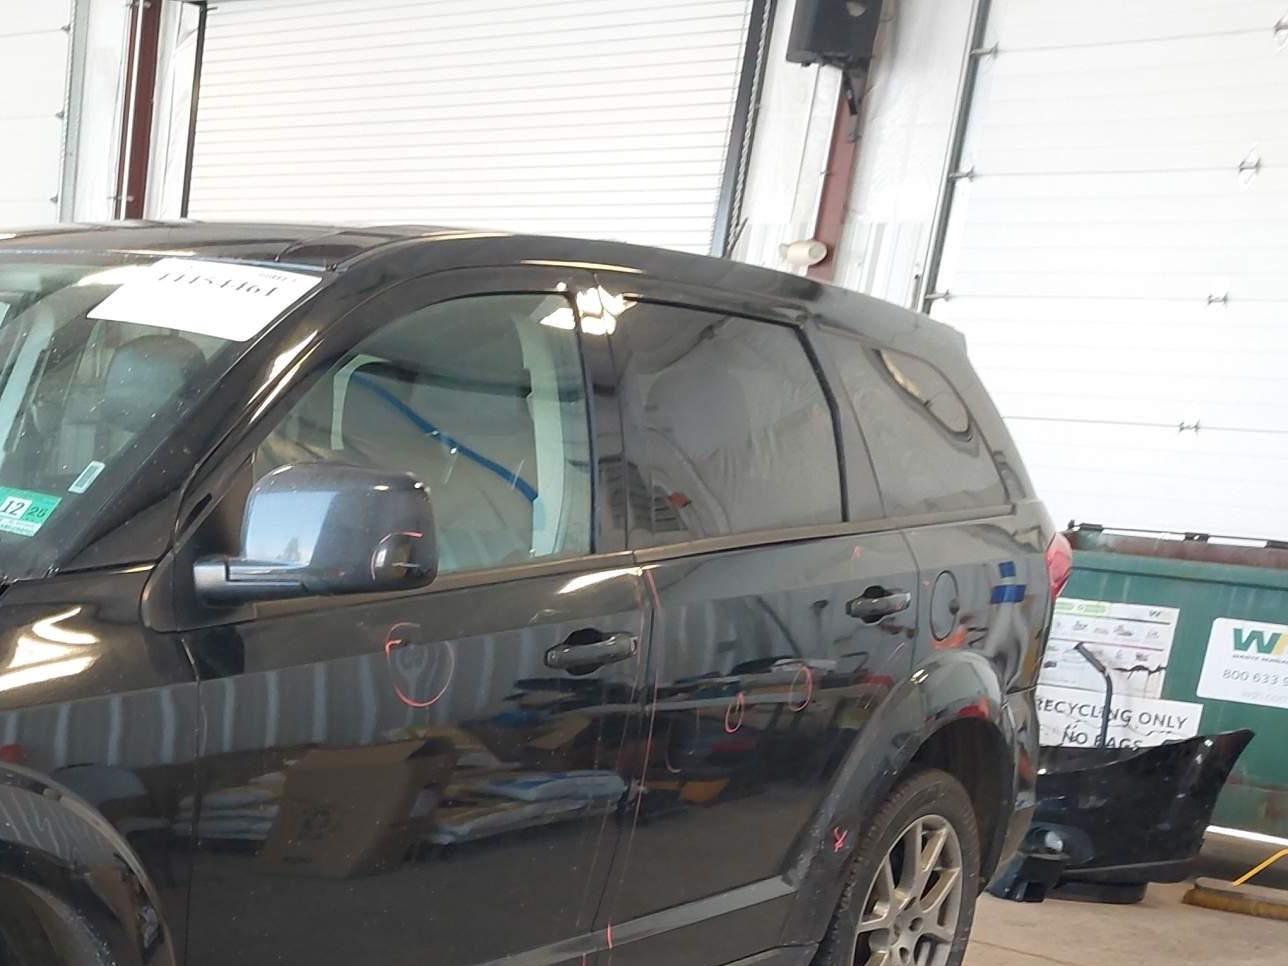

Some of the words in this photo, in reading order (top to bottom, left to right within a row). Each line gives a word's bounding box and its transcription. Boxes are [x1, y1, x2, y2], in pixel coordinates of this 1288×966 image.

[0, 500, 25, 516] 12
[1223, 669, 1249, 681] 800
[1037, 697, 1132, 724] RECYCLNG
[1139, 711, 1188, 730] ONLY
[1062, 729, 1088, 745] NO
